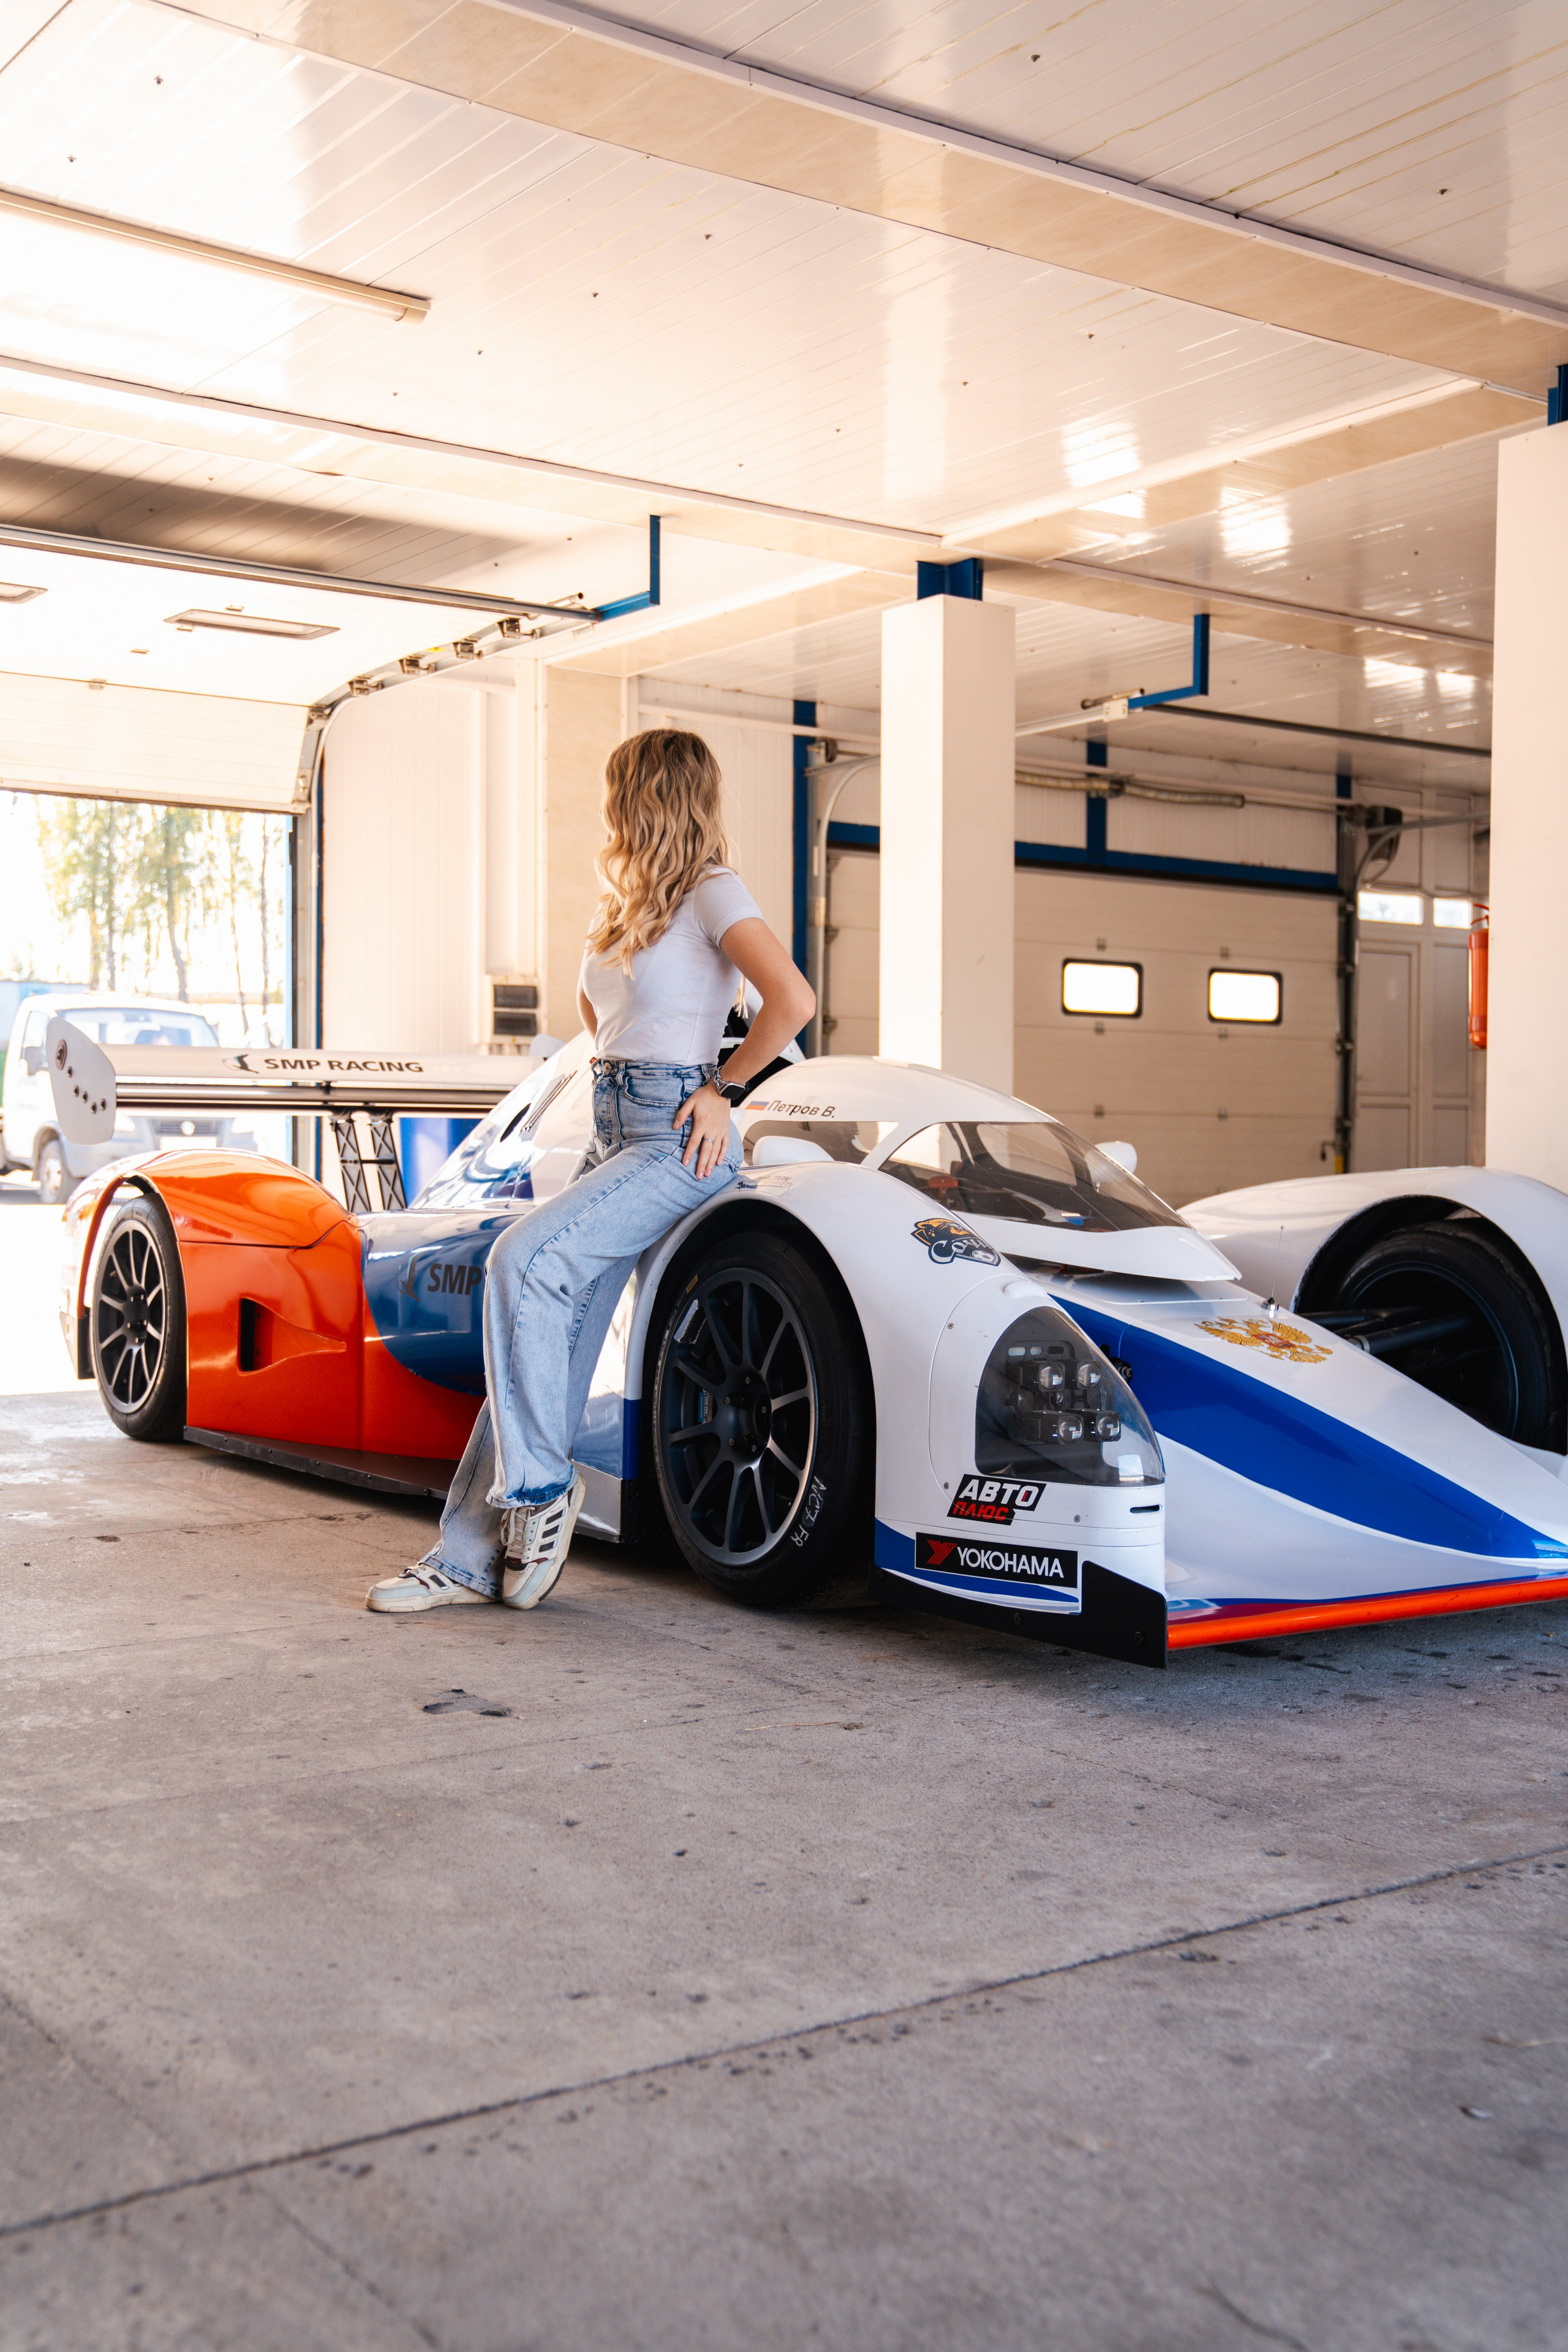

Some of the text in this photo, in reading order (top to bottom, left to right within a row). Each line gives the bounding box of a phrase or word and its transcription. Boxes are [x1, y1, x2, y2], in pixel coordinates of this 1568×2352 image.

[264, 1058, 424, 1072] SMP RACING
[767, 1100, 835, 1118] Петров В.
[428, 1263, 483, 1295] SMP
[958, 1479, 1039, 1507] АВТО
[952, 1501, 1009, 1521] ПЛЮС
[957, 1546, 1065, 1578] YOKOHAMA
